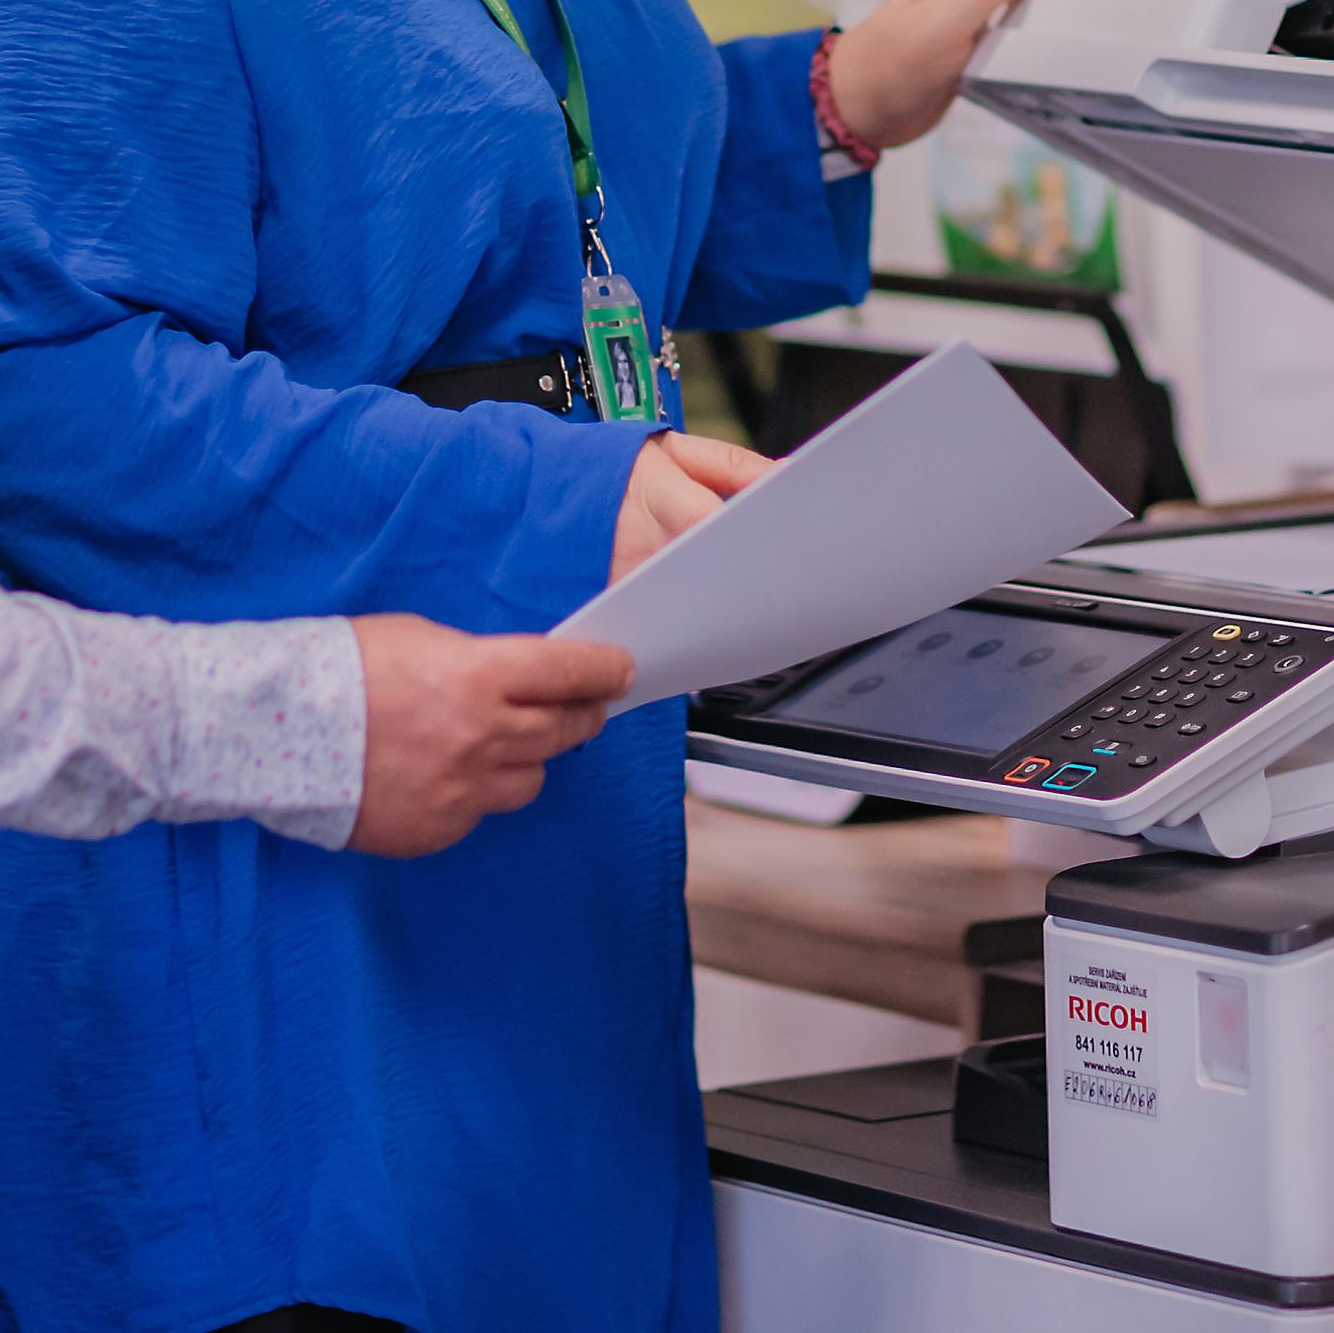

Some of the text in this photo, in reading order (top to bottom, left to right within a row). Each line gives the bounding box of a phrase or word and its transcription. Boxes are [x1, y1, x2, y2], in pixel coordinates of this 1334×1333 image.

[1069, 995, 1147, 1034] RICOH
[1075, 1035, 1143, 1063] 841 116 117
[1083, 1061, 1137, 1078] www.ricoh.cz
